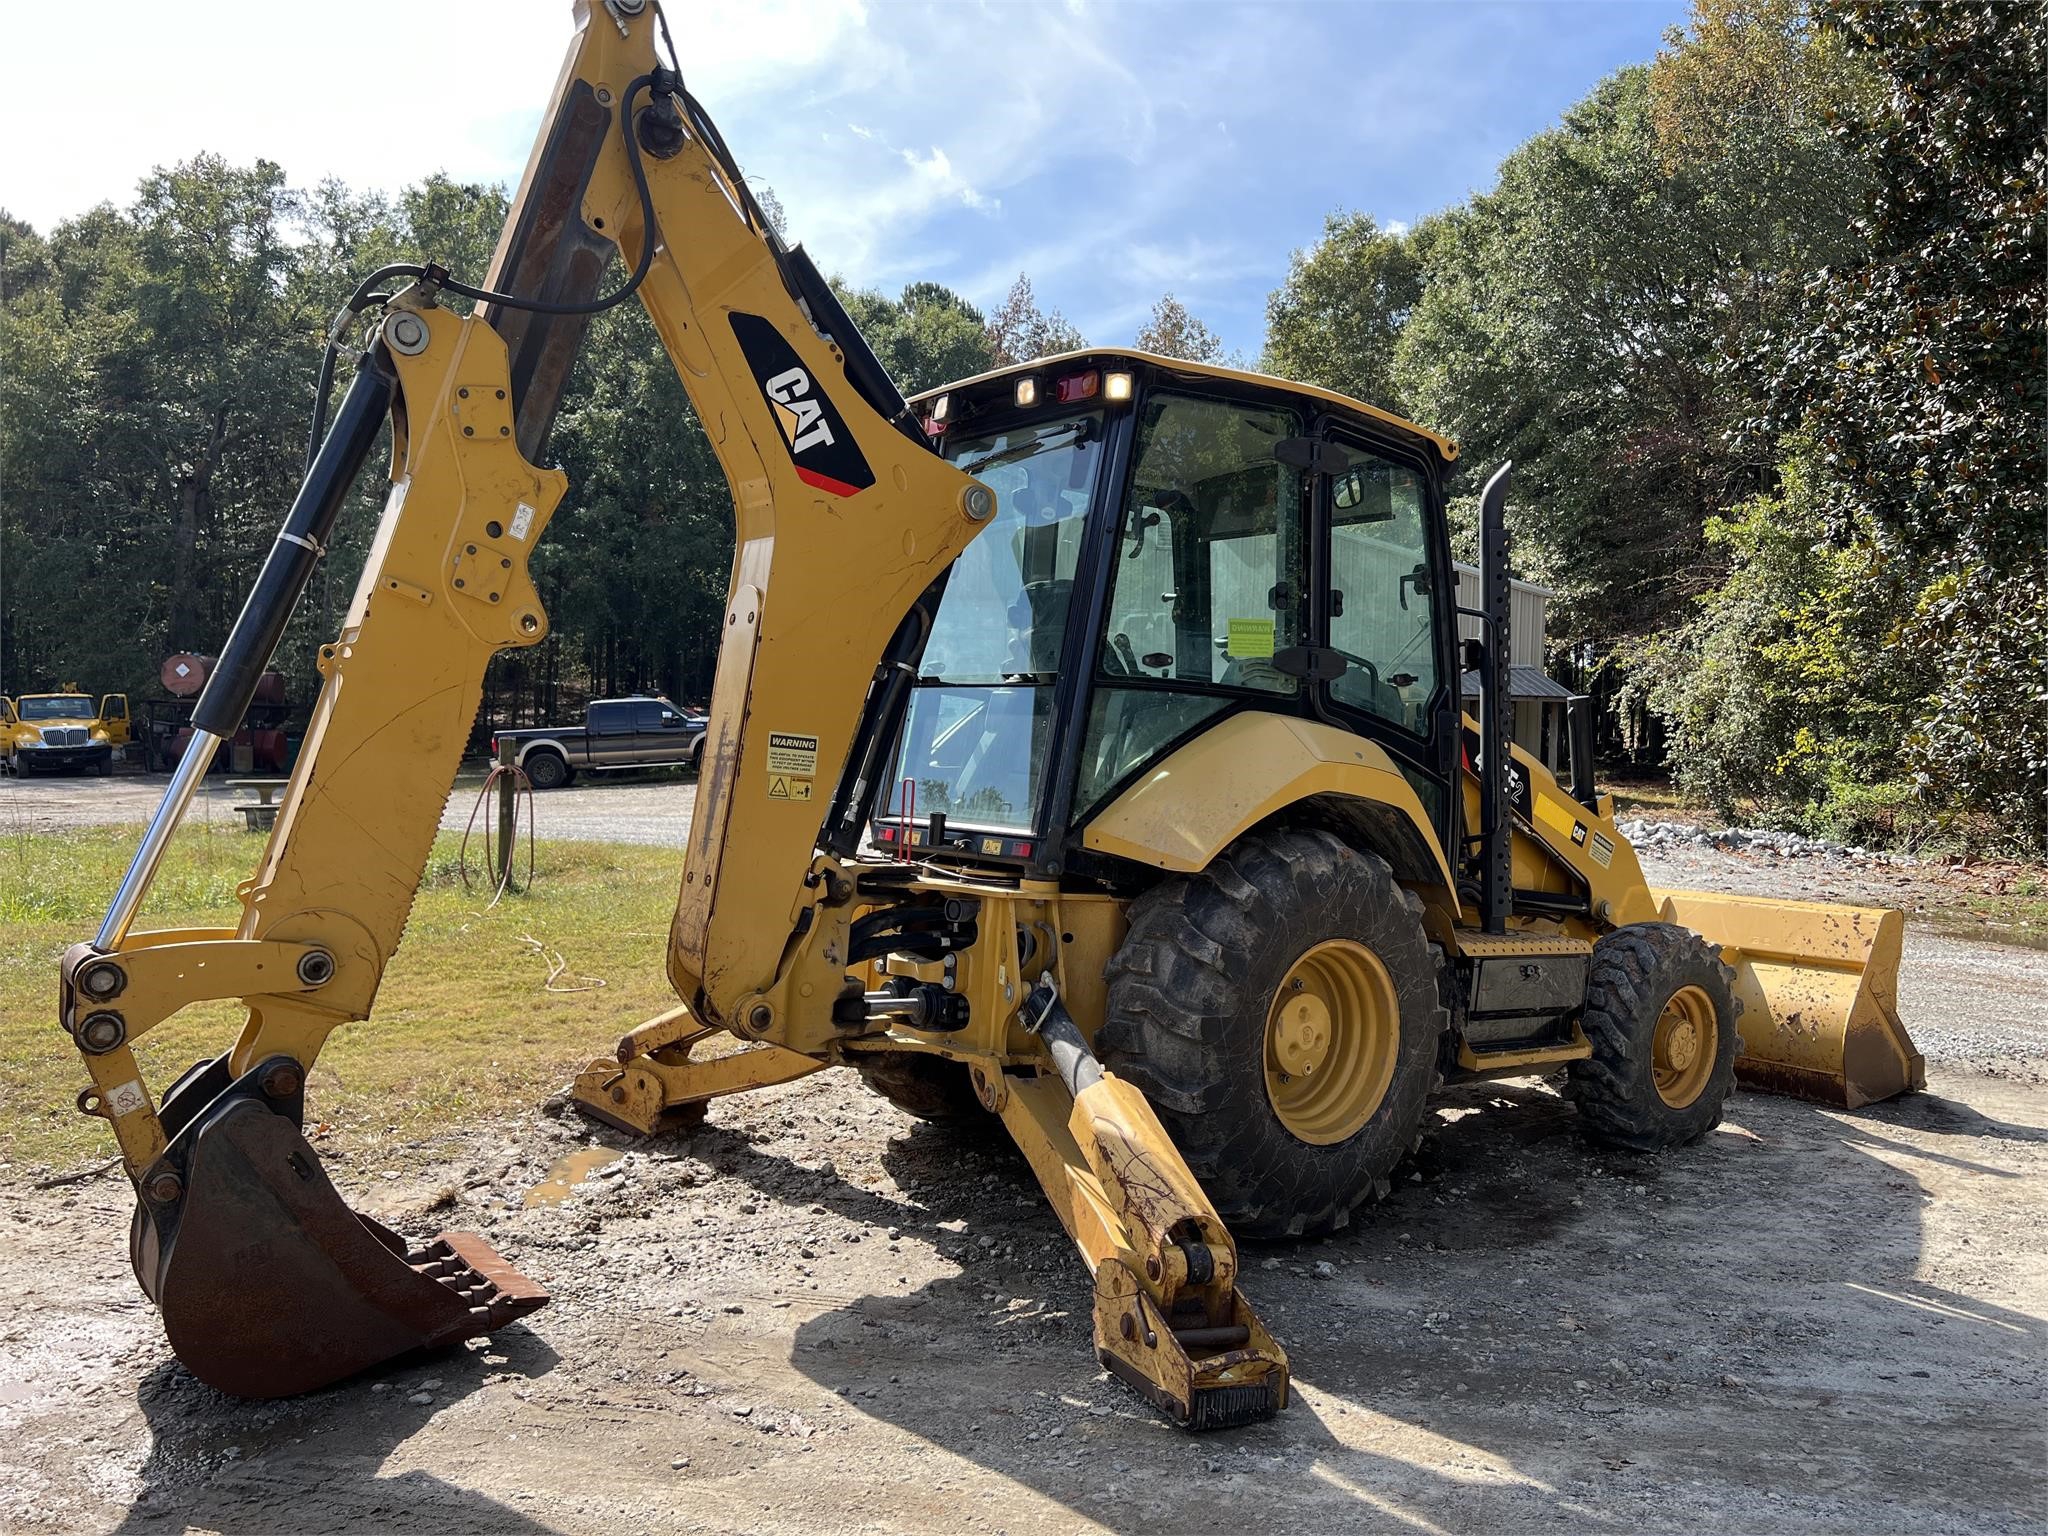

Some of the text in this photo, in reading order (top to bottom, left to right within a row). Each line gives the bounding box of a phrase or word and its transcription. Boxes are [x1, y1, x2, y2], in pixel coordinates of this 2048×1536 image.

[766, 367, 835, 454] CAT
[772, 737, 815, 749] WARNING
[1573, 825, 1586, 842] CAT
